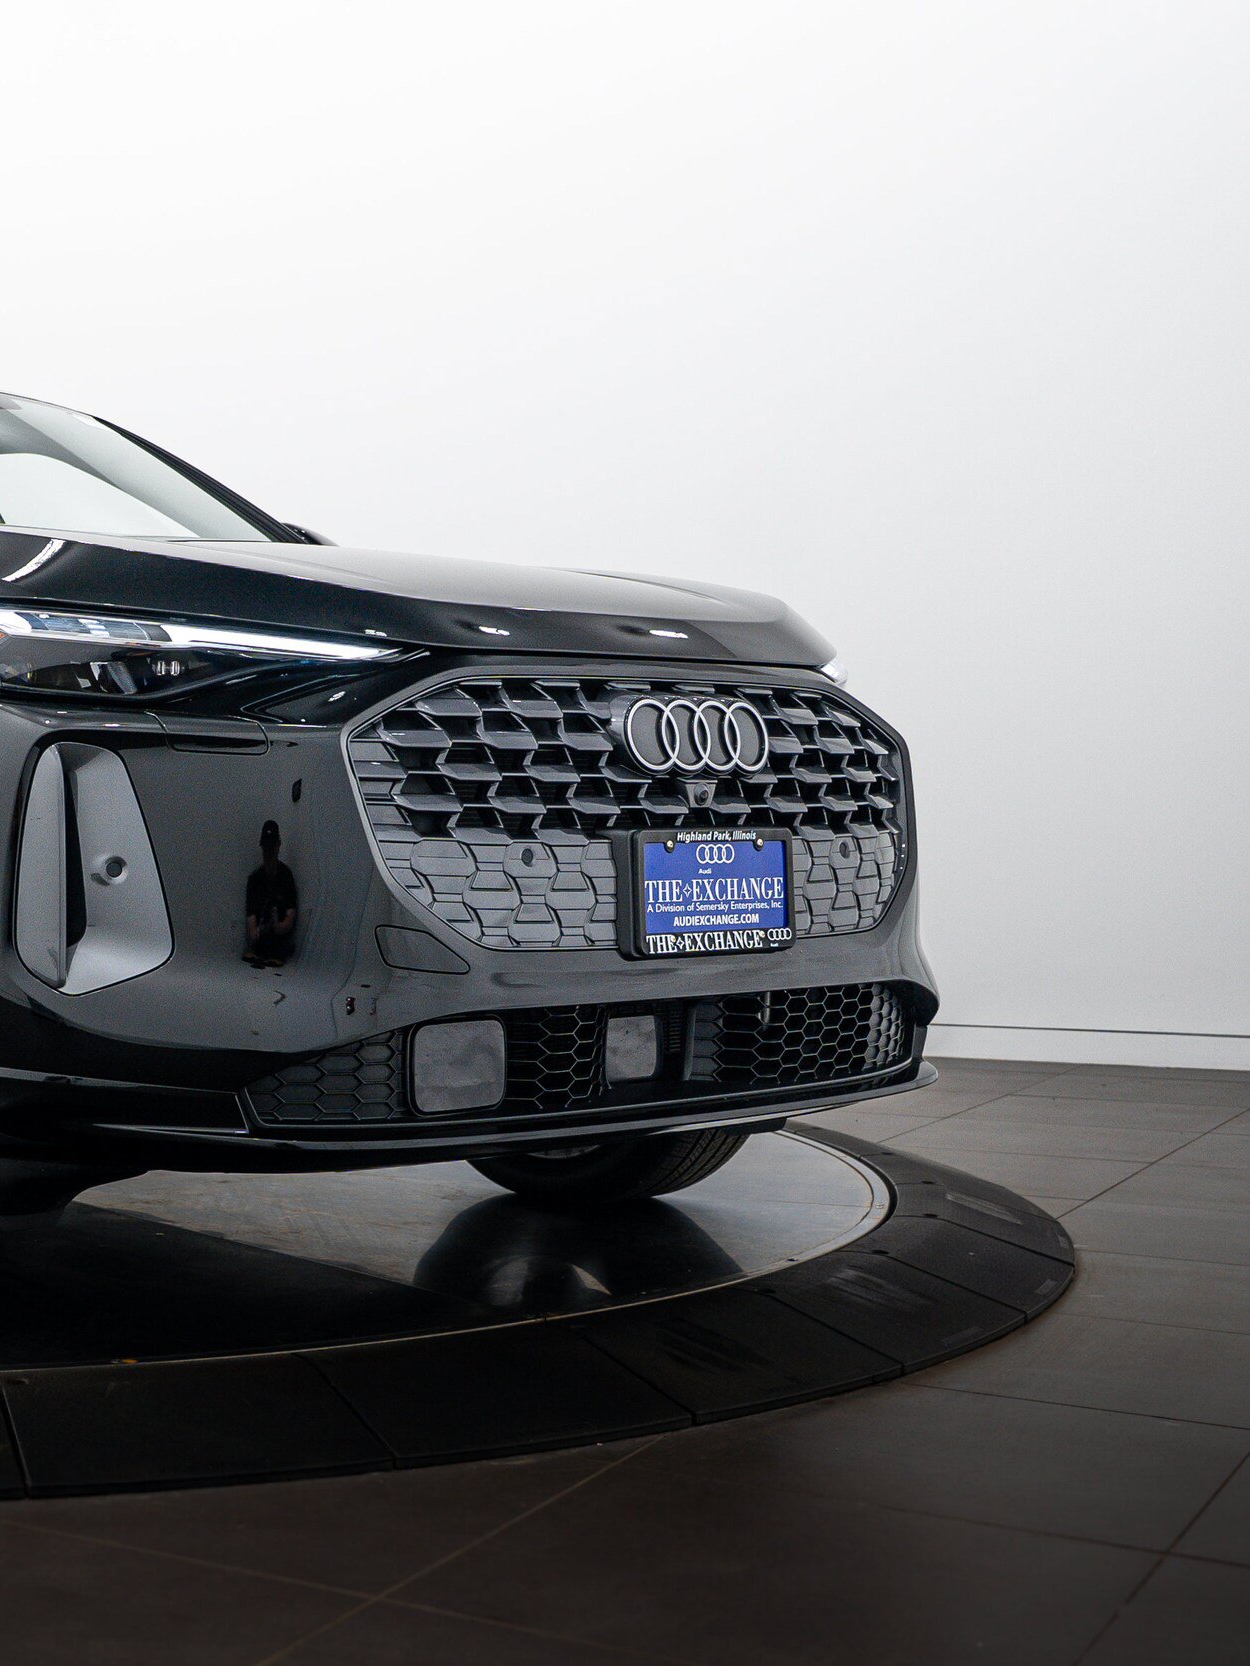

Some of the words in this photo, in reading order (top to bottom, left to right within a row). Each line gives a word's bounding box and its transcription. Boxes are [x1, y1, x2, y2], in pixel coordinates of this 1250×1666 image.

[677, 832, 712, 843] Highland
[713, 831, 732, 841] Park,
[732, 830, 756, 840] Illinois
[647, 905, 654, 913] A
[655, 903, 685, 913] Division
[686, 902, 695, 911] of
[696, 902, 729, 913] Semersky
[731, 901, 770, 911] Enterprises,
[771, 900, 784, 909] Inc.
[673, 913, 760, 927] AUDIEXCHANGE.COM
